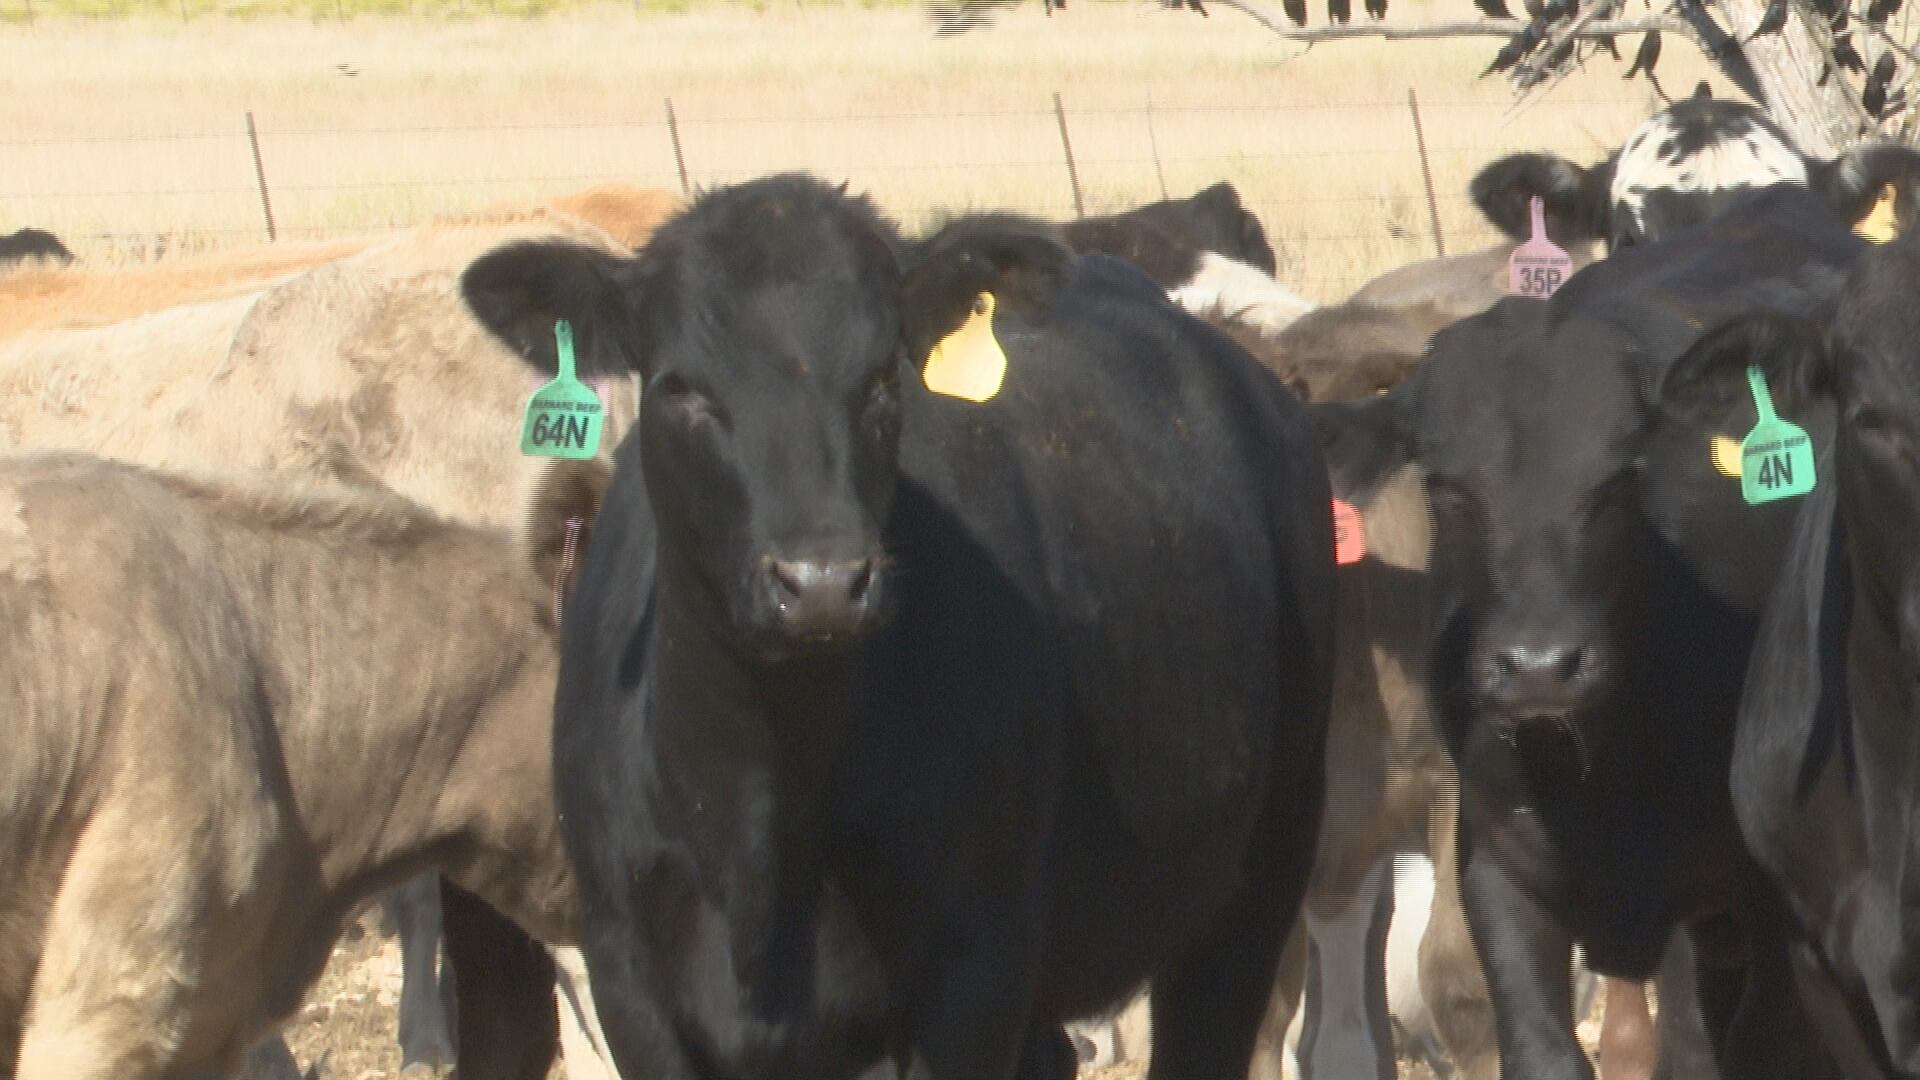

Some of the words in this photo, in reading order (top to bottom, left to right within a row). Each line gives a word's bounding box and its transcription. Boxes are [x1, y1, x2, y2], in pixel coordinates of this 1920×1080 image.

[1520, 267, 1562, 294] 35P
[532, 413, 589, 450] 64N
[1758, 452, 1794, 490] 4N
